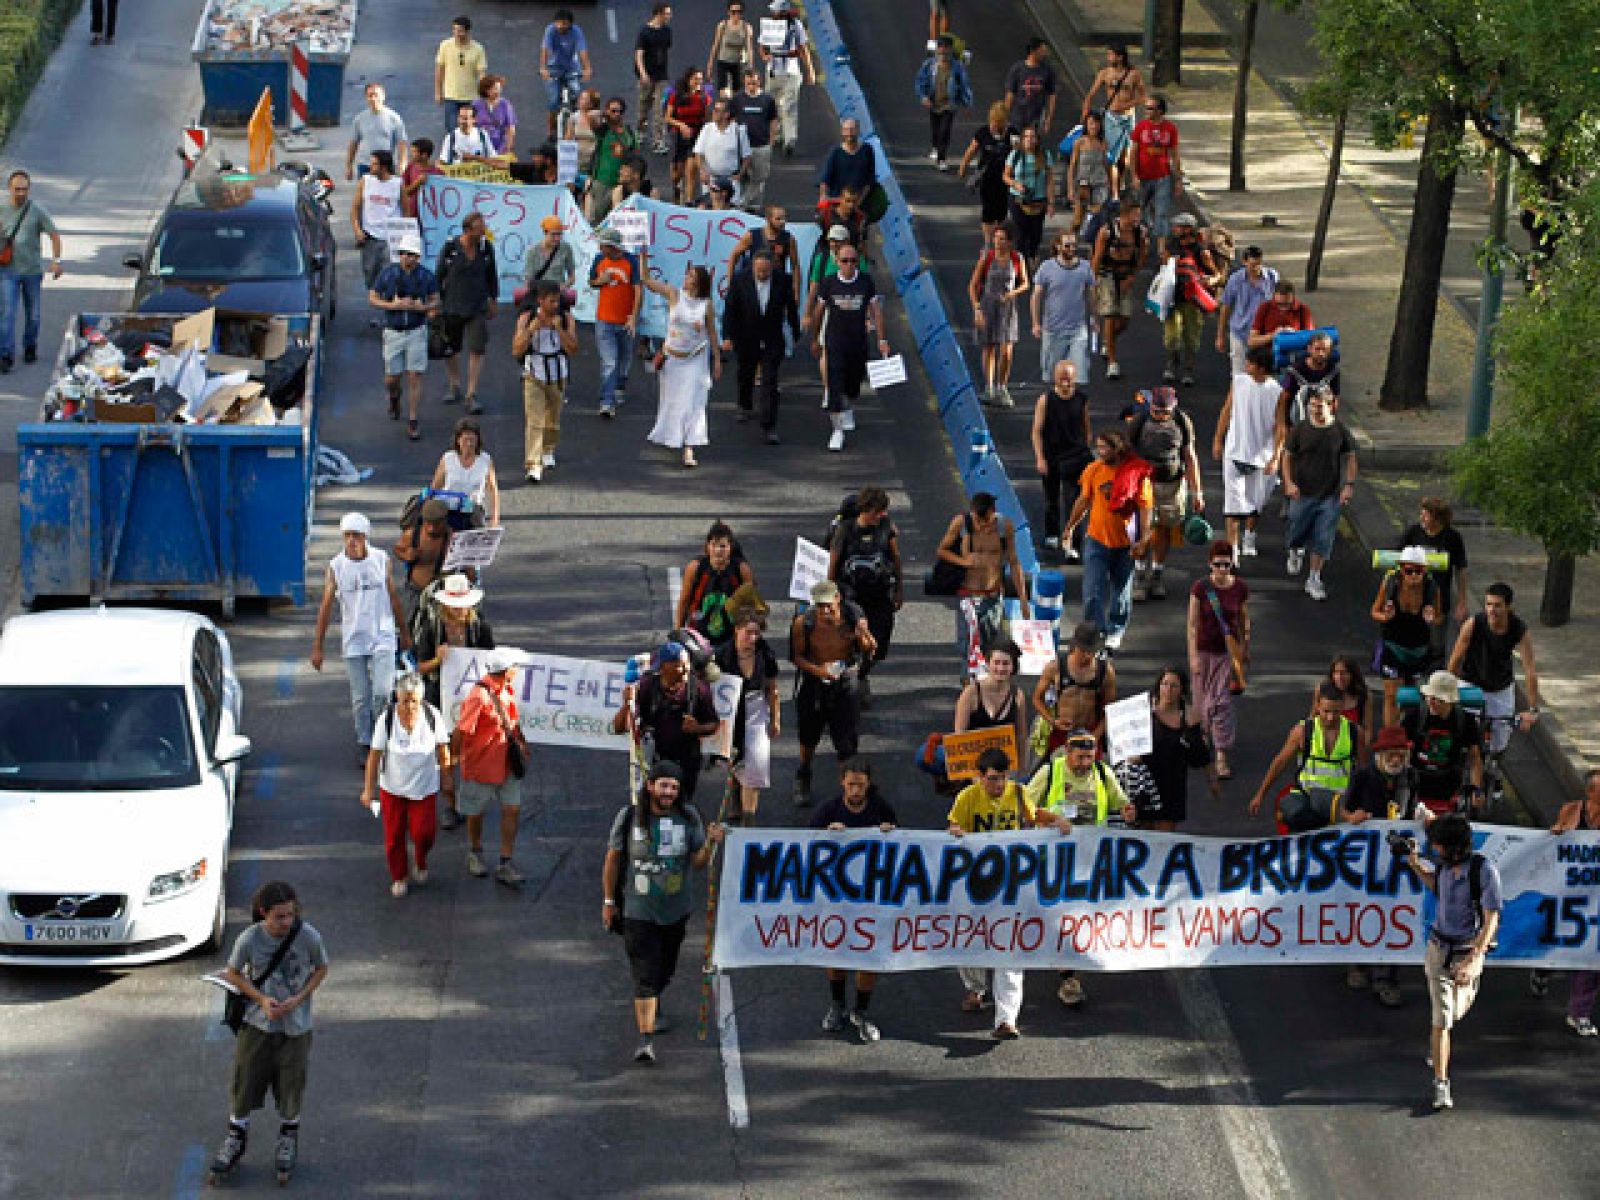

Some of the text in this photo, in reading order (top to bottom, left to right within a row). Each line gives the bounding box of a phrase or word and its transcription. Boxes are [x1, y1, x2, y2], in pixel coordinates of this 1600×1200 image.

[422, 184, 462, 219] NO
[454, 655, 570, 706] ATE
[574, 678, 599, 698] EN
[740, 840, 933, 908] MARCHA
[934, 837, 1150, 907] POPULAR
[1155, 841, 1203, 899] A
[754, 914, 877, 951] VAMOS
[1057, 906, 1168, 953] PORQUE
[1178, 905, 1283, 948] VAMOS
[1298, 901, 1416, 950] LEJOS
[1537, 894, 1600, 948] 15-
